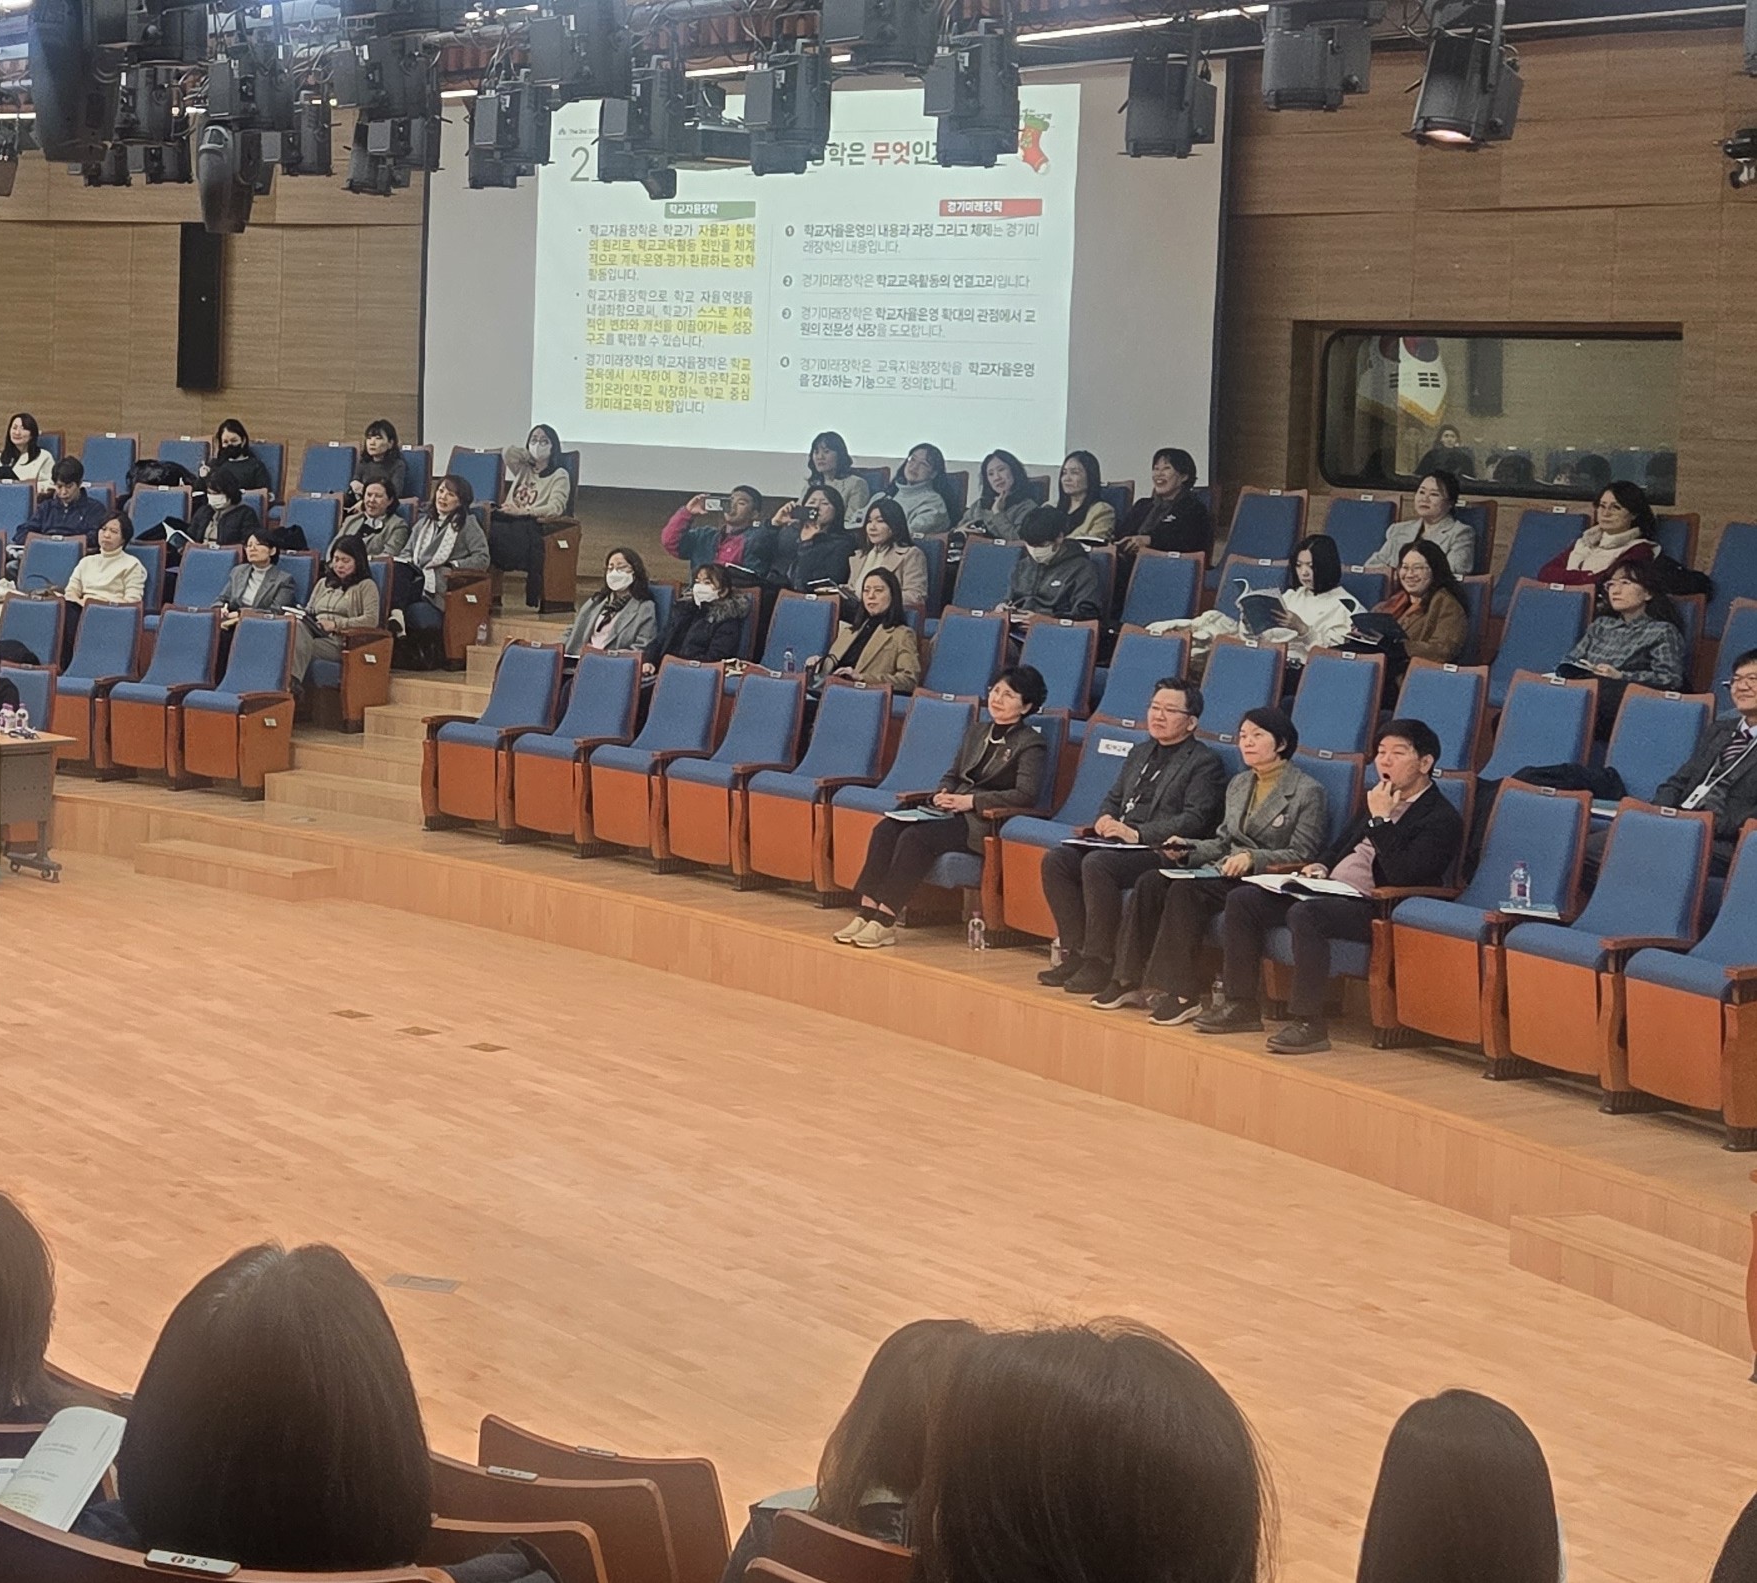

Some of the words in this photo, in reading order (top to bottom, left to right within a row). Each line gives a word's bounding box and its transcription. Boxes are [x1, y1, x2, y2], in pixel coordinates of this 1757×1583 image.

[811, 142, 866, 166] 학은
[570, 146, 590, 182] 2
[669, 204, 718, 215] 학교자율장학
[947, 201, 1003, 213] 경기미래장학
[589, 224, 658, 237] 학교자율장학은
[663, 224, 693, 237] 학교가
[699, 224, 729, 237] 자율과
[804, 224, 876, 237] 학교자율운영의
[878, 224, 910, 237] 내용과
[911, 224, 934, 237] 과정
[935, 224, 968, 237] 그리고
[1006, 223, 1039, 237] 경기미
[637, 239, 696, 252] 학교교육활동
[734, 255, 755, 268] 장학
[803, 274, 874, 288] 경기미래장학은
[877, 274, 950, 288] 학교교육활동의
[588, 289, 668, 303] 학교자율장학으로
[674, 290, 694, 302] 학교
[662, 305, 693, 318] 학교가
[697, 306, 728, 318] 스스로
[1025, 310, 1036, 322] 교
[822, 323, 854, 337] 전문성
[649, 335, 659, 346] 수
[586, 353, 654, 368] 경기미래장학의
[800, 358, 872, 372] 경기미래장학은
[704, 387, 724, 399] 학교
